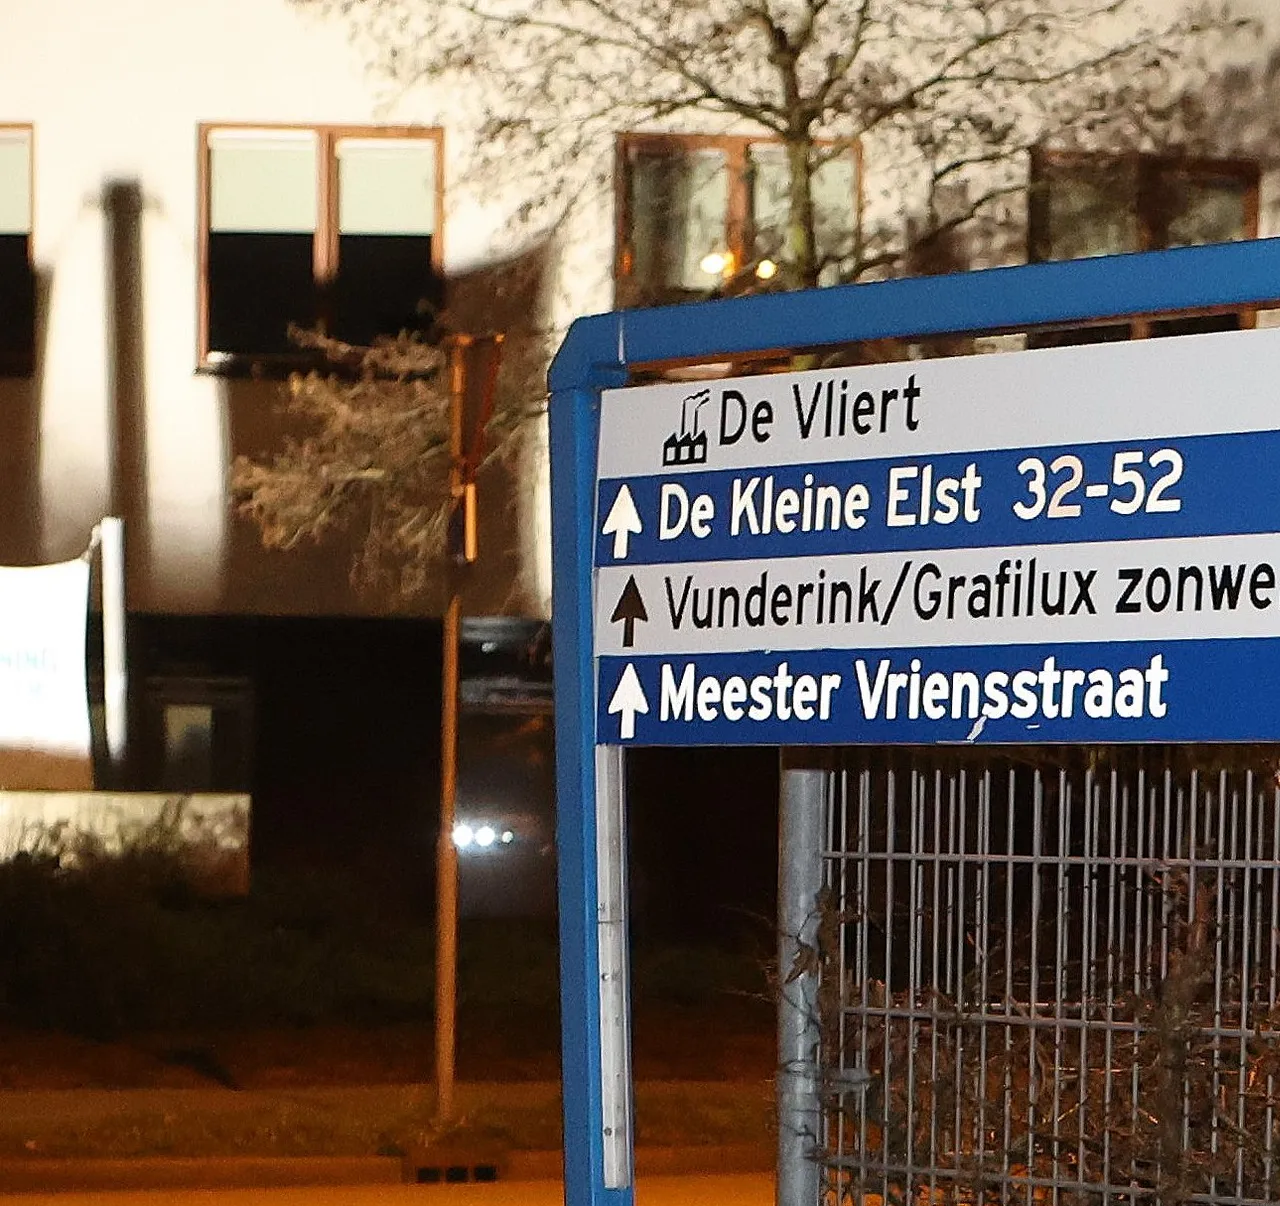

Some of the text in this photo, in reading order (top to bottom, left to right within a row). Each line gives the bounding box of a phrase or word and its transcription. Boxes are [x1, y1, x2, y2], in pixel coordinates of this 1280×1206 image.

[718, 373, 922, 446] De Vliert
[658, 448, 1185, 541] De Kleine Elst 32-52
[664, 556, 1098, 631] Vunderink/Grafilux
[658, 653, 1169, 723] Meester Vriensstraat
